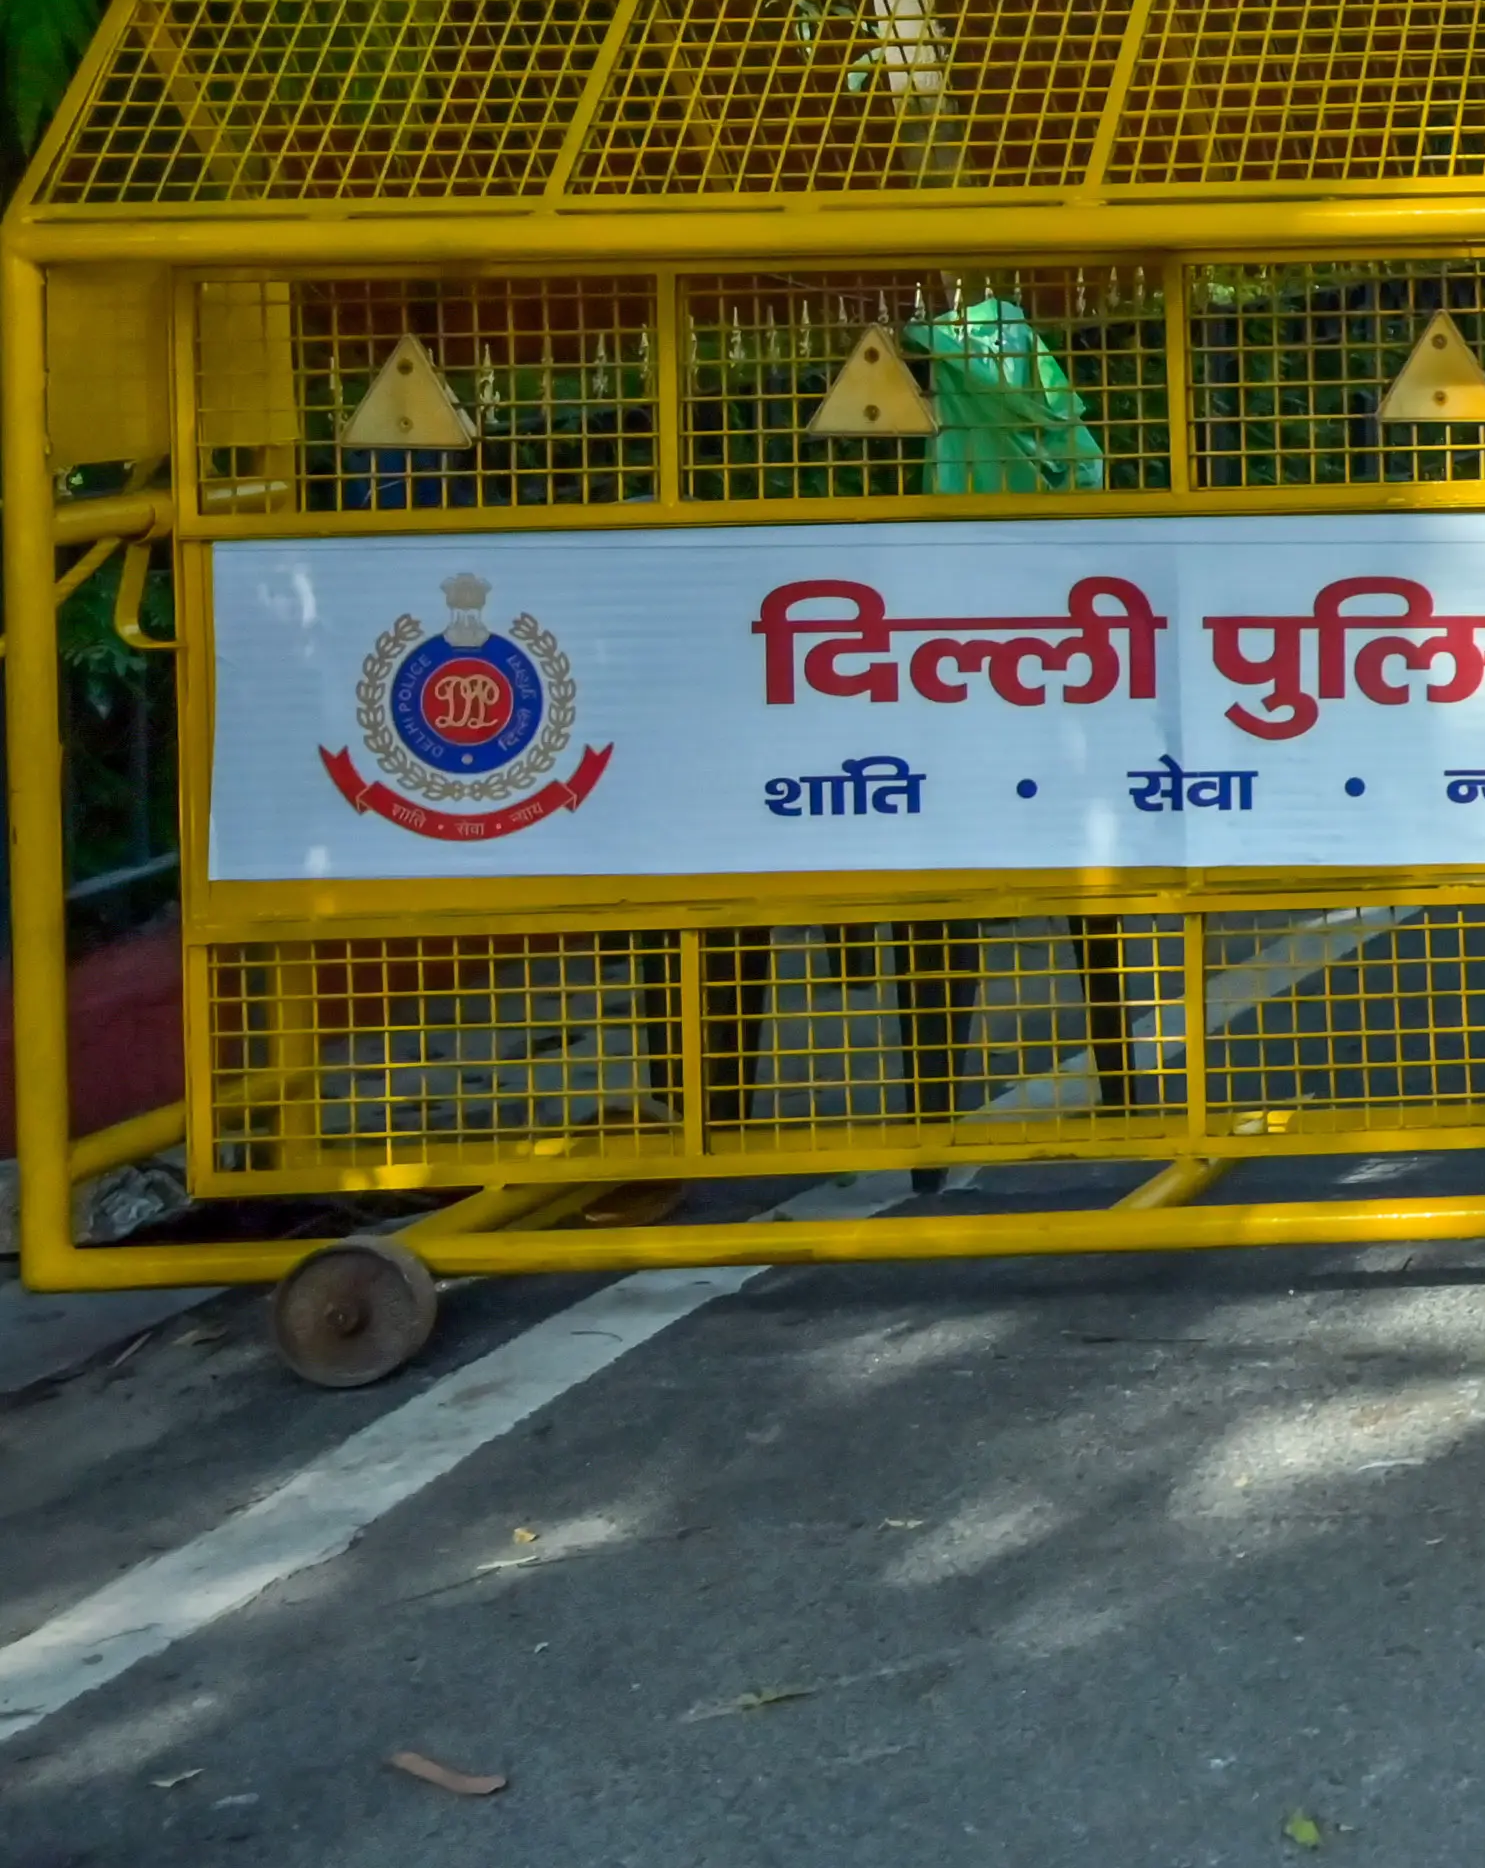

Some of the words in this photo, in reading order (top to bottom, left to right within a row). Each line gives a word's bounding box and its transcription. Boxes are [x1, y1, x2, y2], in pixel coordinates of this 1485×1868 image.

[751, 575, 1168, 705] दिल्ली
[398, 654, 433, 712] POLICE
[402, 717, 444, 759] DELHI
[764, 755, 927, 816] शांति
[1127, 754, 1258, 812] सेवा
